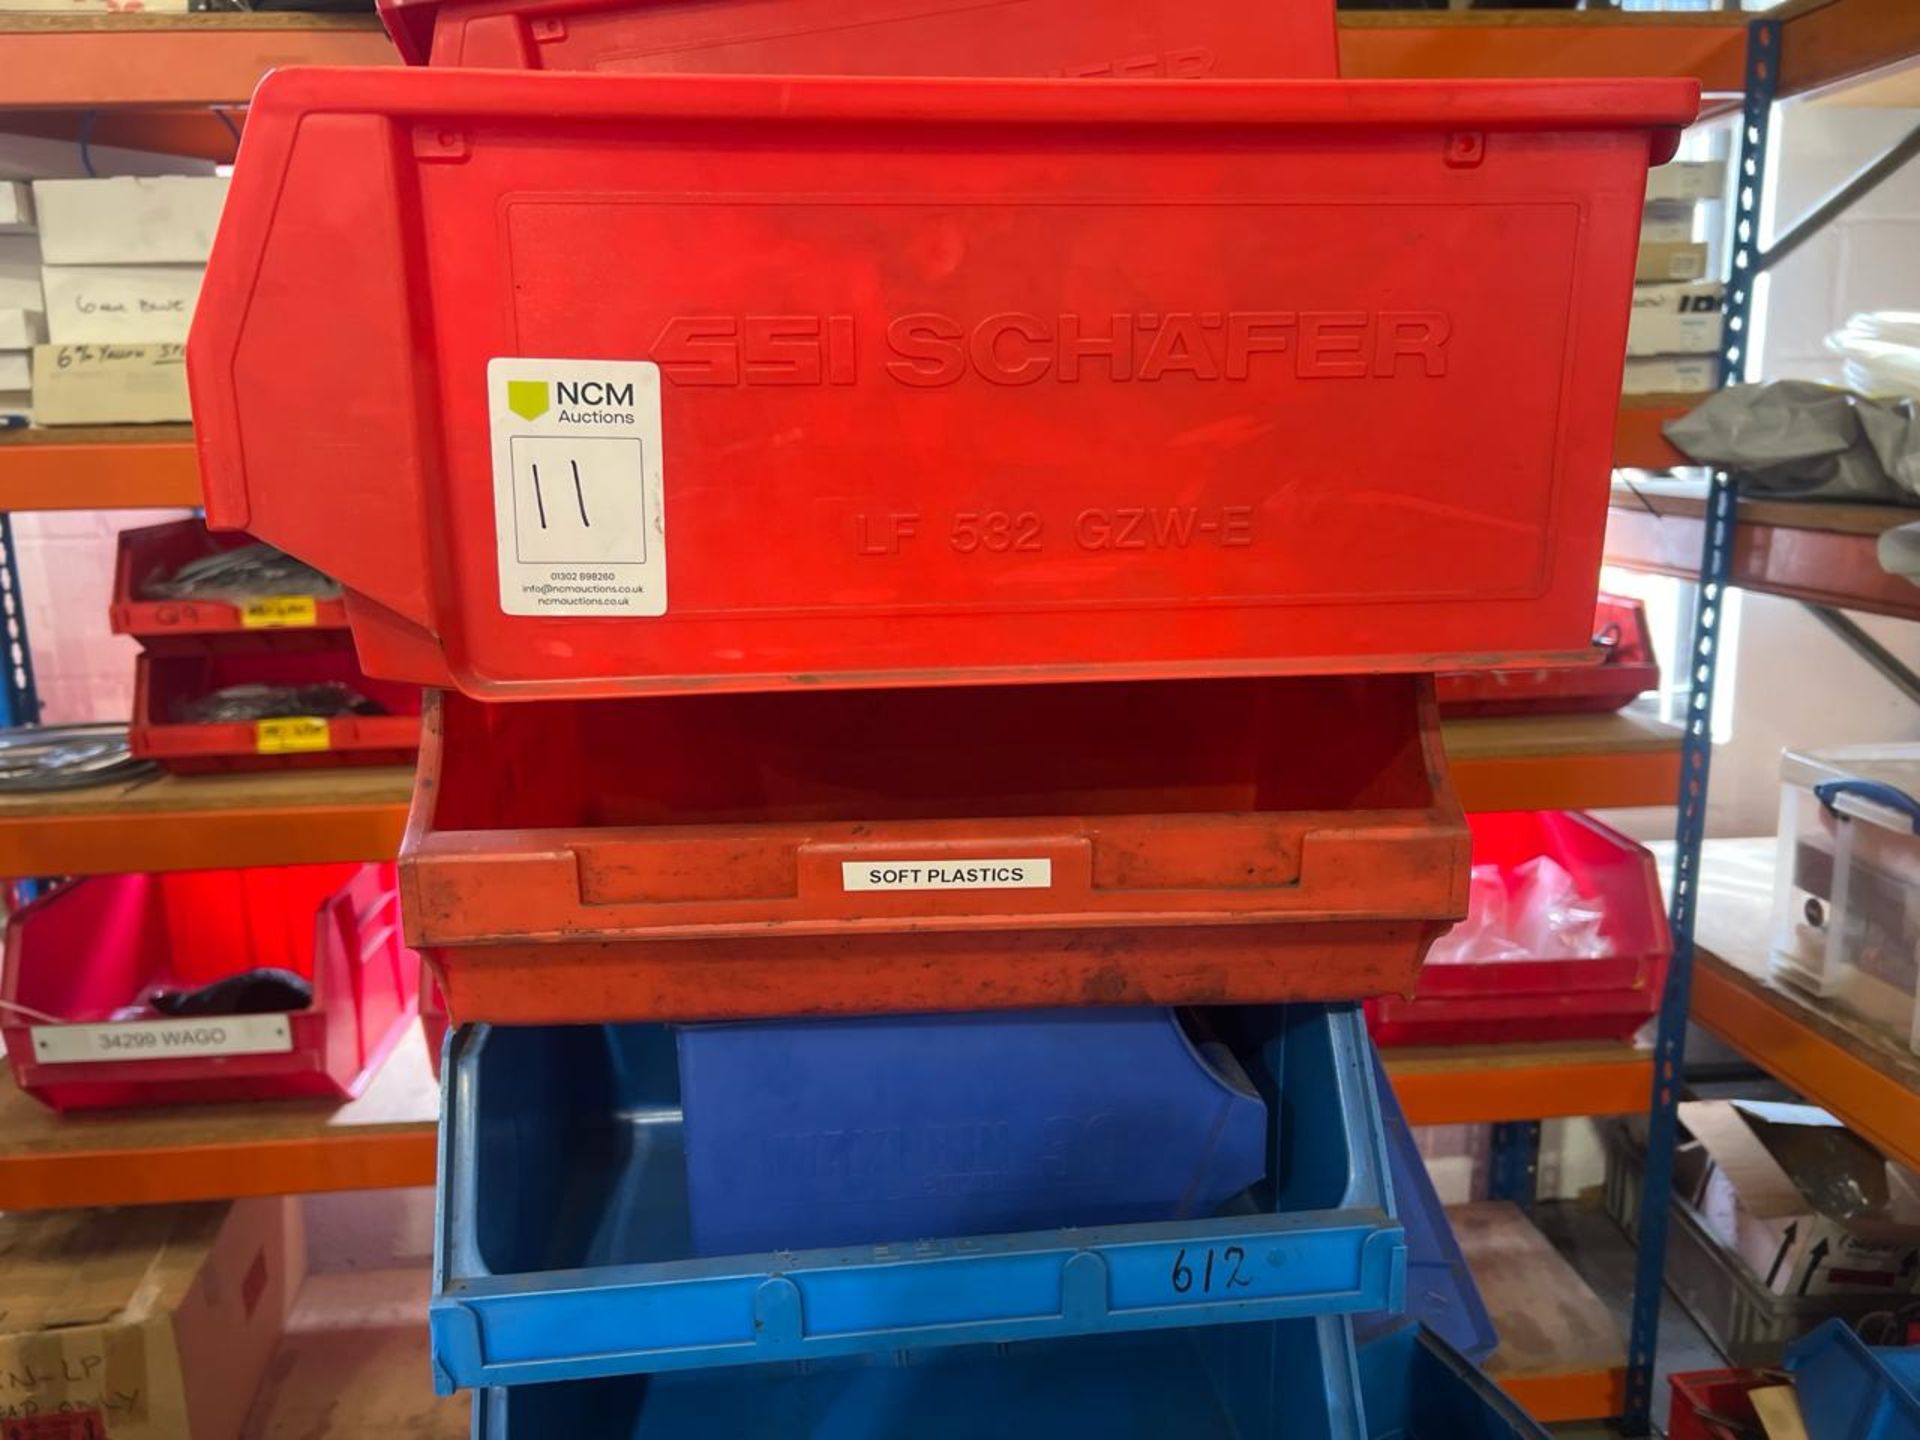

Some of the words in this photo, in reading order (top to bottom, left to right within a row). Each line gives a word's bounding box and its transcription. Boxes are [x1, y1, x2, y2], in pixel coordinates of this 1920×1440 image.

[647, 315, 854, 387] SSI
[886, 310, 1450, 388] SCHÄFER
[556, 381, 635, 407] NCM
[557, 409, 636, 425] Auctions
[531, 459, 591, 530] 11
[856, 512, 921, 556] LF
[949, 510, 1045, 554] 532
[1074, 504, 1254, 551] GZW-E
[550, 572, 577, 582] 01302
[522, 584, 644, 595] info@ncmauctions.co.uk
[537, 596, 630, 606] ncmauctions.co.uk
[869, 868, 922, 885] SOFT
[927, 867, 1024, 883] PLASTICS
[98, 1031, 157, 1051] 34299
[161, 1028, 227, 1046] WAGO
[1172, 1245, 1253, 1294] 612
